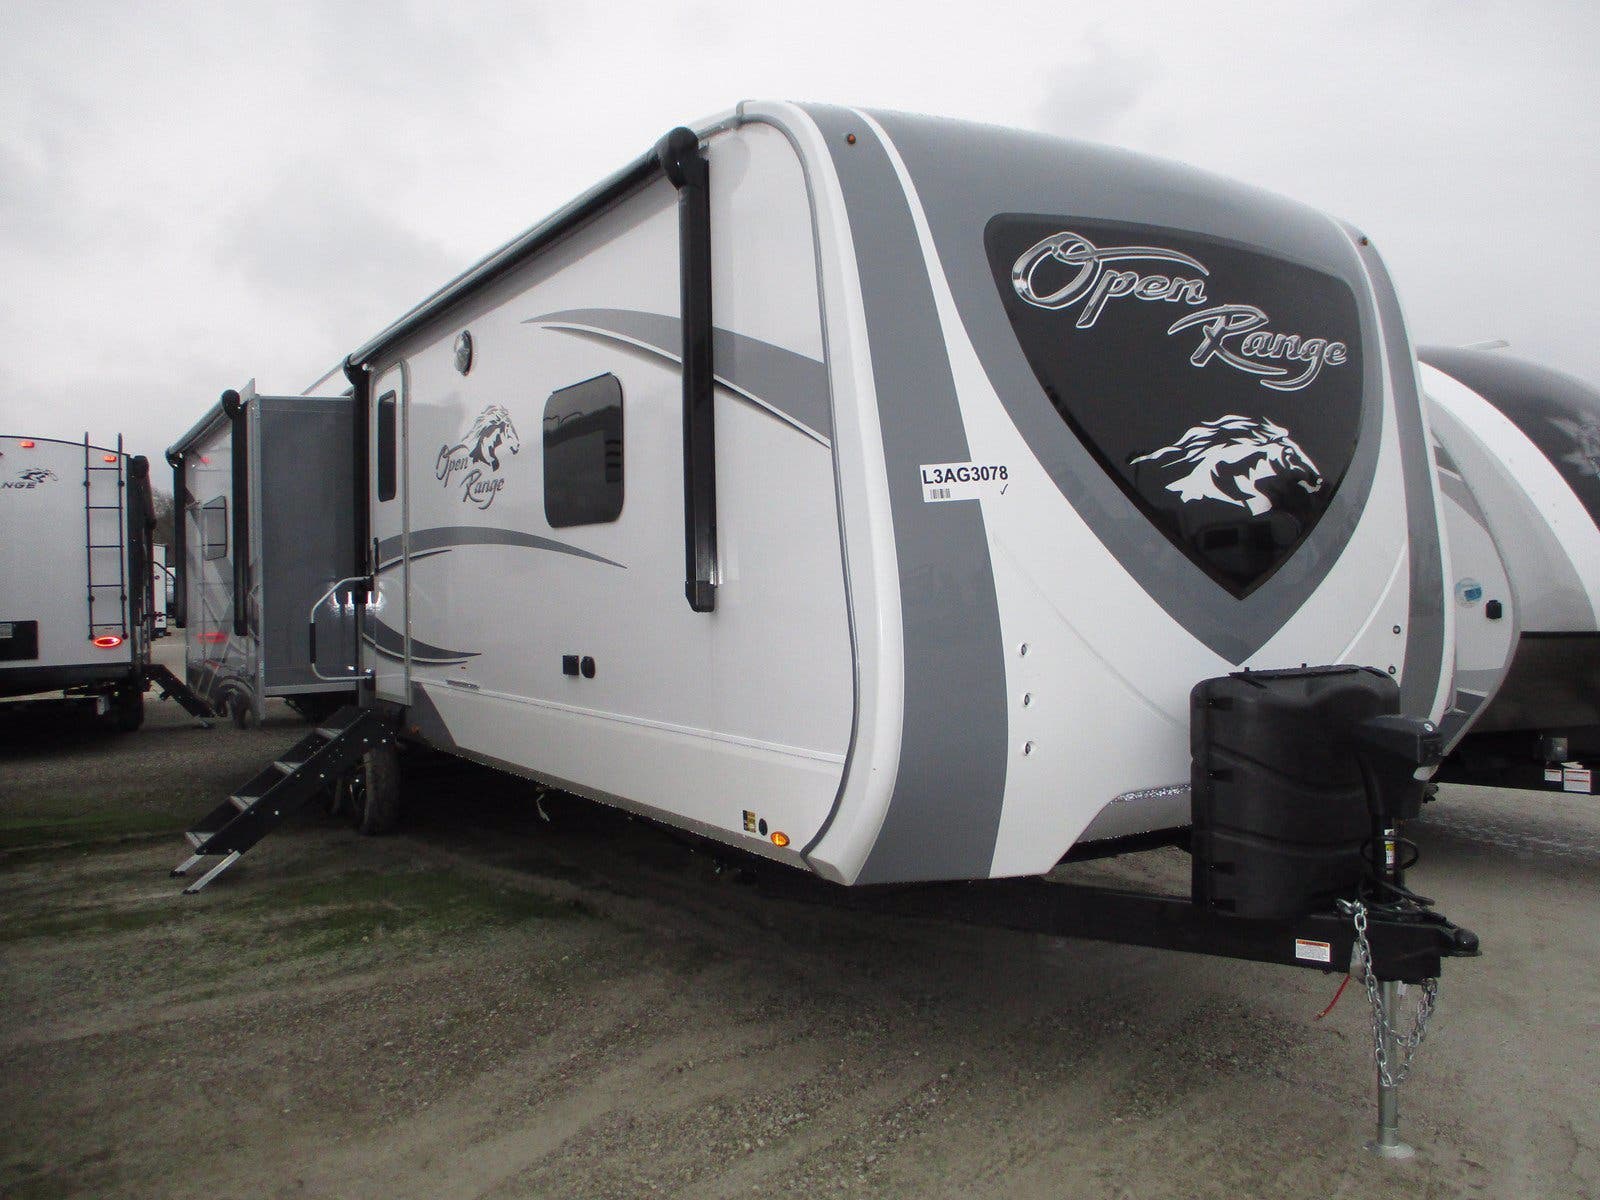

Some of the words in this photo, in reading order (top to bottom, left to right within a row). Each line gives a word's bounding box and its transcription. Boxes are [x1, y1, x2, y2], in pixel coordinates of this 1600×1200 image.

[1011, 231, 1209, 328] Open
[1167, 304, 1348, 391] Range
[436, 444, 470, 488] Open
[922, 465, 1009, 485] L3AG3078
[459, 468, 505, 510] Range
